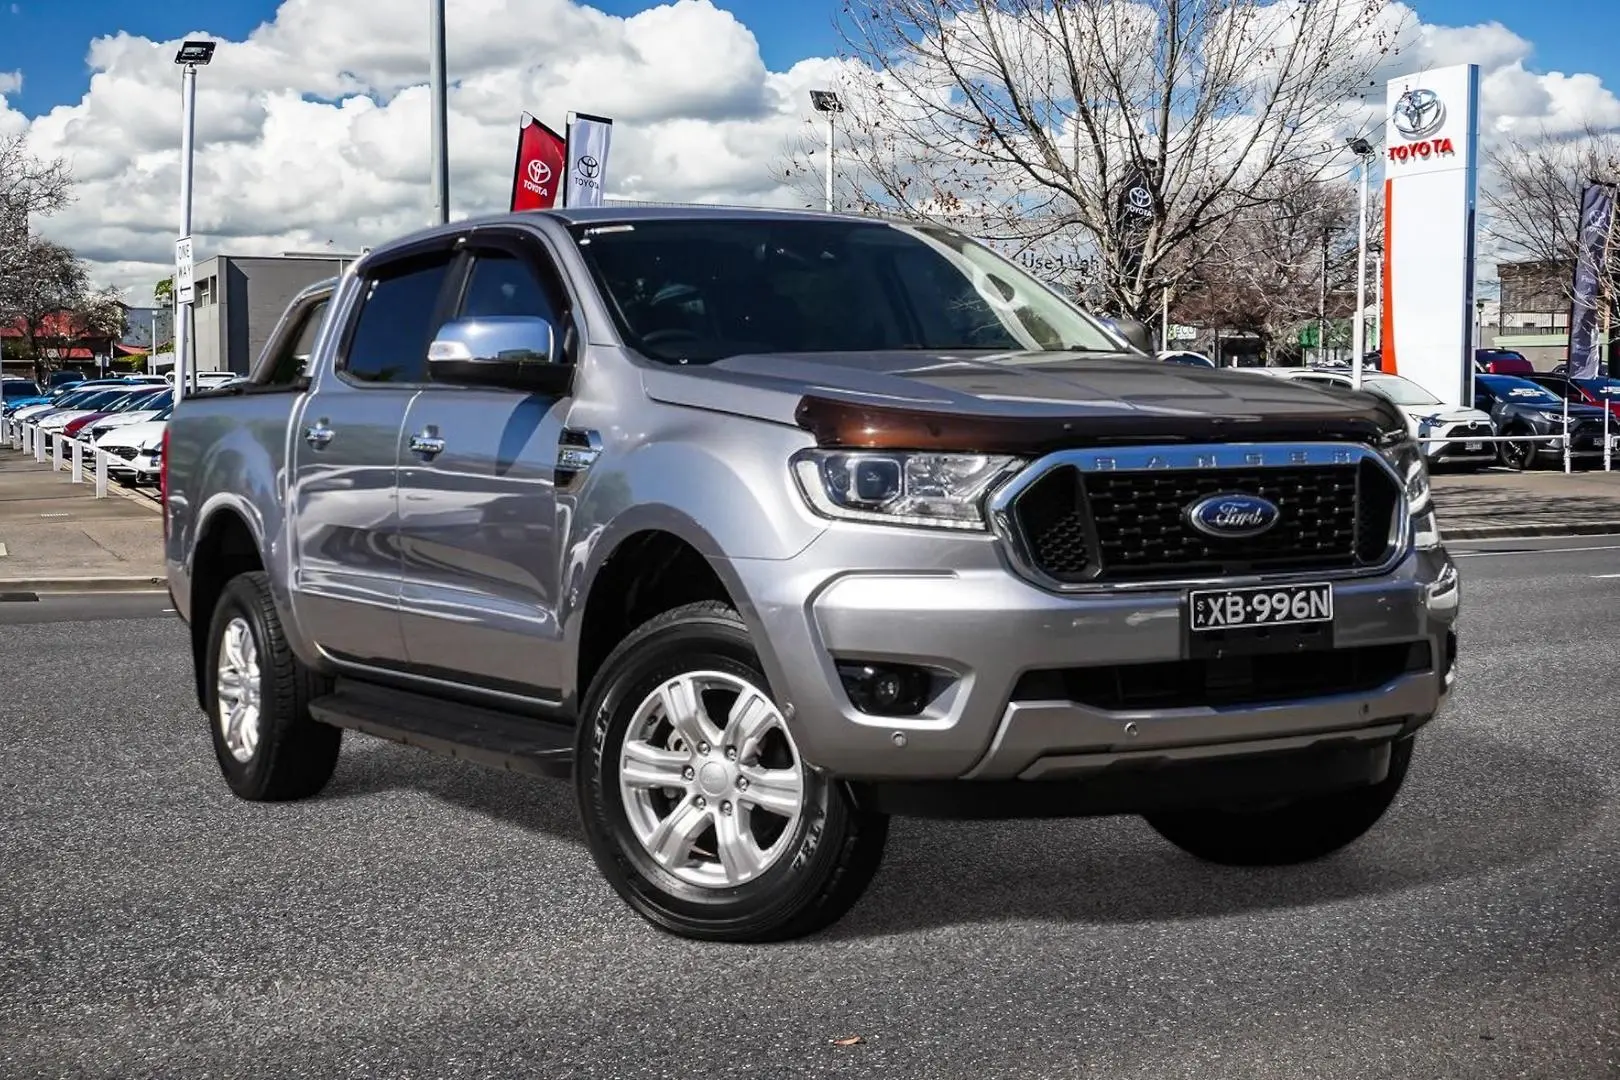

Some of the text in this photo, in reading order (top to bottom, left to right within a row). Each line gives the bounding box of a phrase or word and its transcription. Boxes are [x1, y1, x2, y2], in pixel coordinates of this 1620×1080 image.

[1389, 138, 1454, 160] TOYOTA
[524, 180, 548, 196] TOYOTA
[178, 244, 189, 260] ONE
[1021, 252, 1064, 270] Used
[179, 265, 191, 278] WAY
[1096, 452, 1349, 470] RANGER
[1210, 502, 1262, 526] Ford
